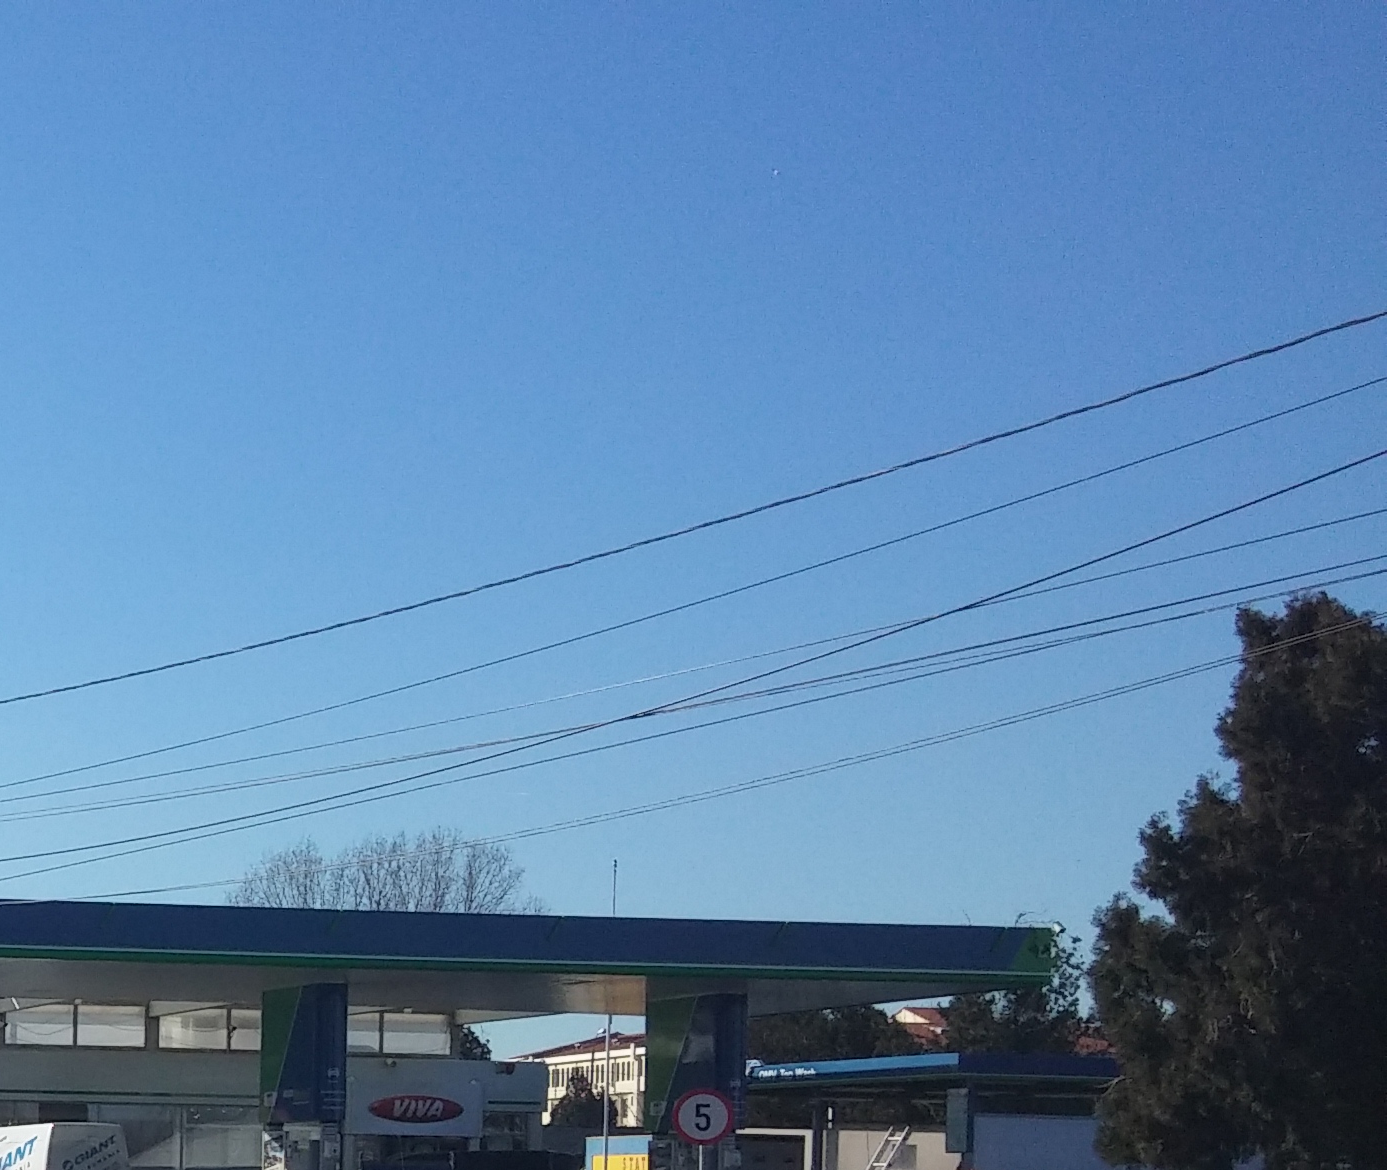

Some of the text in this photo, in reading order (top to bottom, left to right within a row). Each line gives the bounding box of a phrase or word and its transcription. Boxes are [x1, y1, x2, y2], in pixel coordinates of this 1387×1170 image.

[393, 1099, 444, 1118] VIVA
[694, 1103, 711, 1132] 5
[74, 1134, 116, 1165] GIANT
